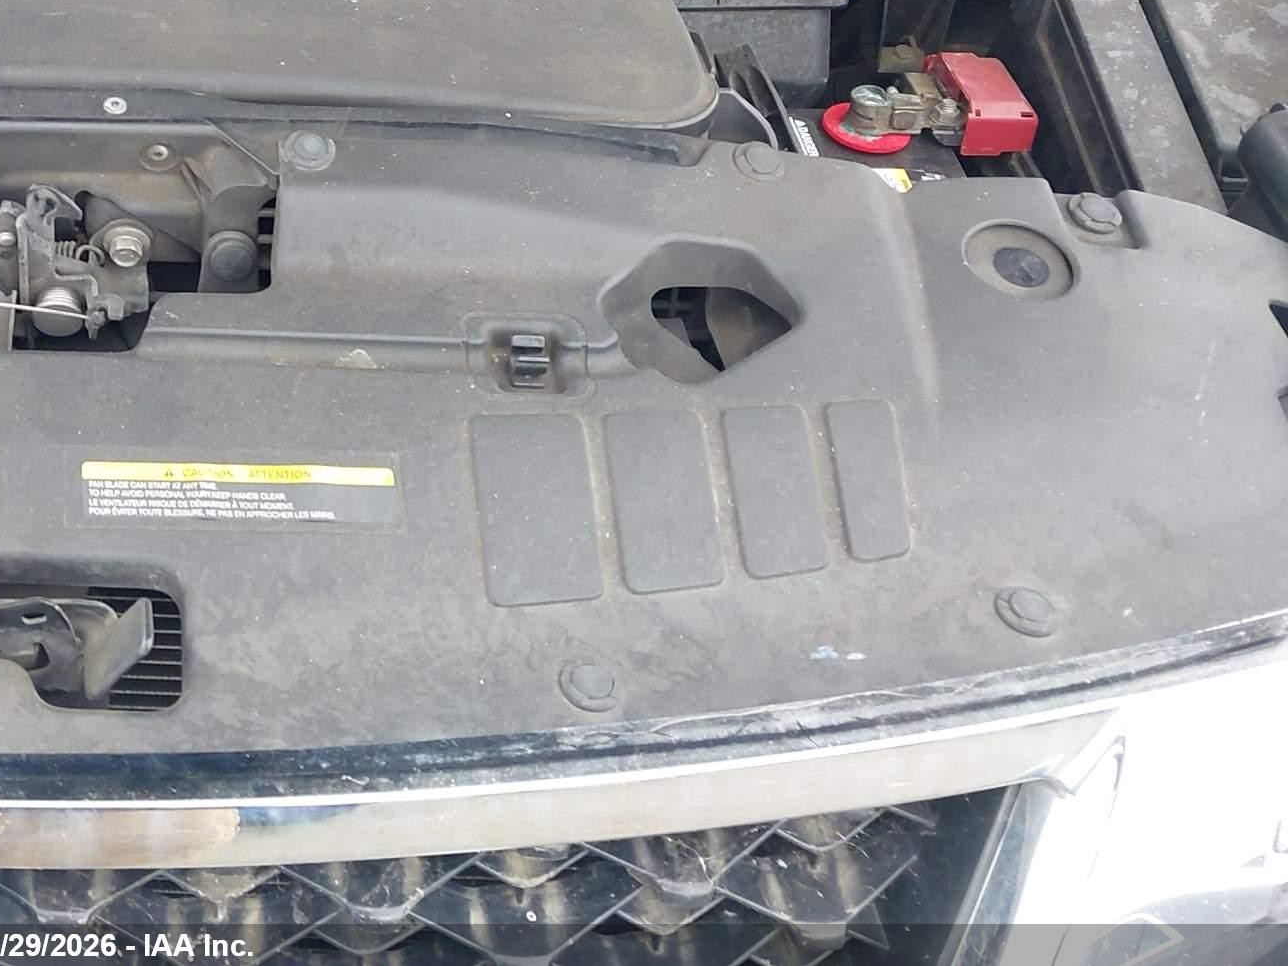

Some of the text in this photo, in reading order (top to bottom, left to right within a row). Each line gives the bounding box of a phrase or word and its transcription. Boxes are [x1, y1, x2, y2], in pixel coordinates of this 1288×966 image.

[798, 126, 819, 157] DANGER
[248, 469, 312, 480] ATTENTION
[104, 480, 129, 489] BLADE
[129, 481, 147, 489] CAN
[147, 481, 171, 489] START
[171, 481, 181, 490] AT
[182, 482, 199, 490] ANY
[88, 488, 100, 497] TO
[100, 489, 120, 497] HELP
[120, 489, 145, 498] AVOID
[145, 490, 184, 499] PERSONAL
[88, 498, 98, 507] LE
[177, 500, 188, 508] DE
[238, 501, 259, 509] TOUT
[88, 507, 111, 515] POUR
[138, 508, 162, 516] TOUTE
[217, 509, 234, 517] PAS
[234, 510, 246, 518] EN
[295, 510, 309, 519] LES
